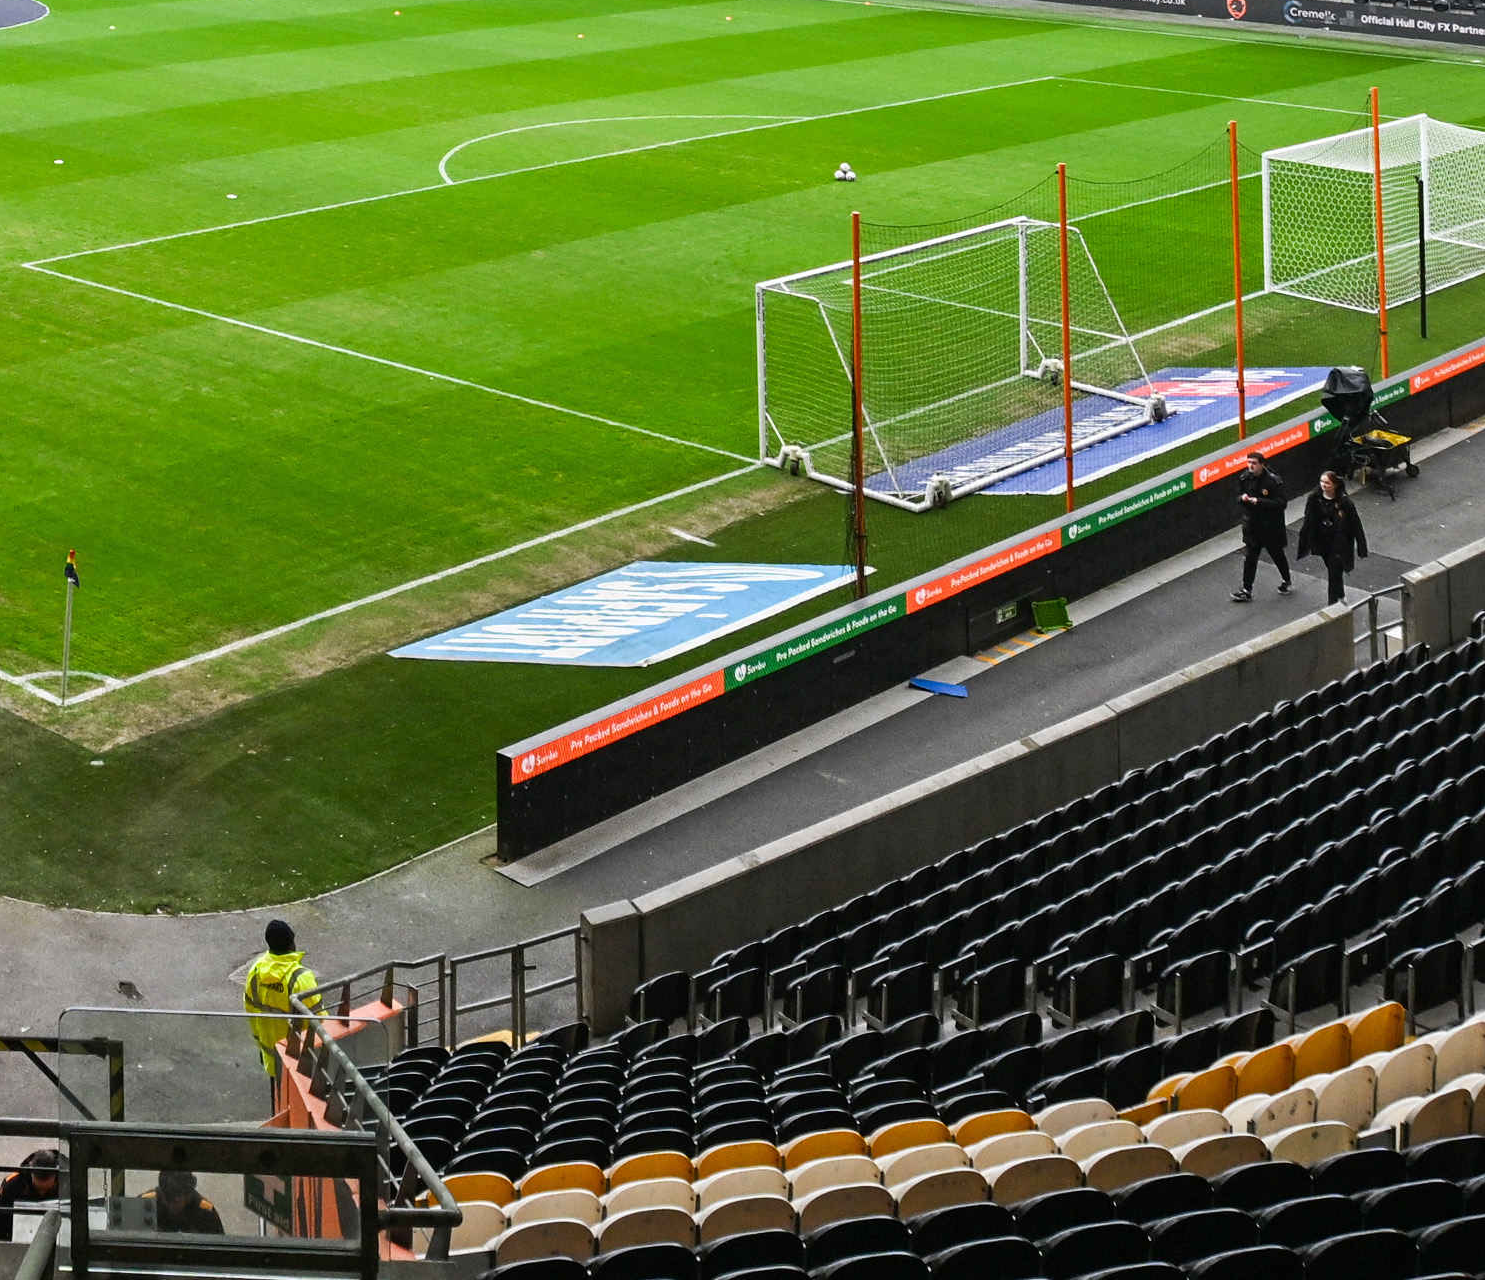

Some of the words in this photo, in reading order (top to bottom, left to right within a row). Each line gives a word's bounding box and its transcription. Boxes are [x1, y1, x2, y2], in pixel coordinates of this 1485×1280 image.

[1361, 14, 1394, 28] Official
[1396, 18, 1414, 30] Hull
[1417, 19, 1435, 33] City
[1438, 22, 1451, 33] FX
[776, 651, 787, 663] Pre
[787, 640, 810, 659] Packed
[811, 627, 846, 648] Sandwiches
[845, 623, 852, 633] &
[852, 616, 869, 630] Foods
[878, 607, 888, 617] the
[888, 604, 897, 614] Go
[570, 738, 583, 752] Pre
[584, 726, 610, 745] Packed
[612, 709, 652, 734] Sandwiches
[653, 706, 660, 716] &
[660, 699, 680, 713] Foods
[680, 694, 689, 705] on
[689, 688, 702, 701] the
[703, 683, 712, 694] Go
